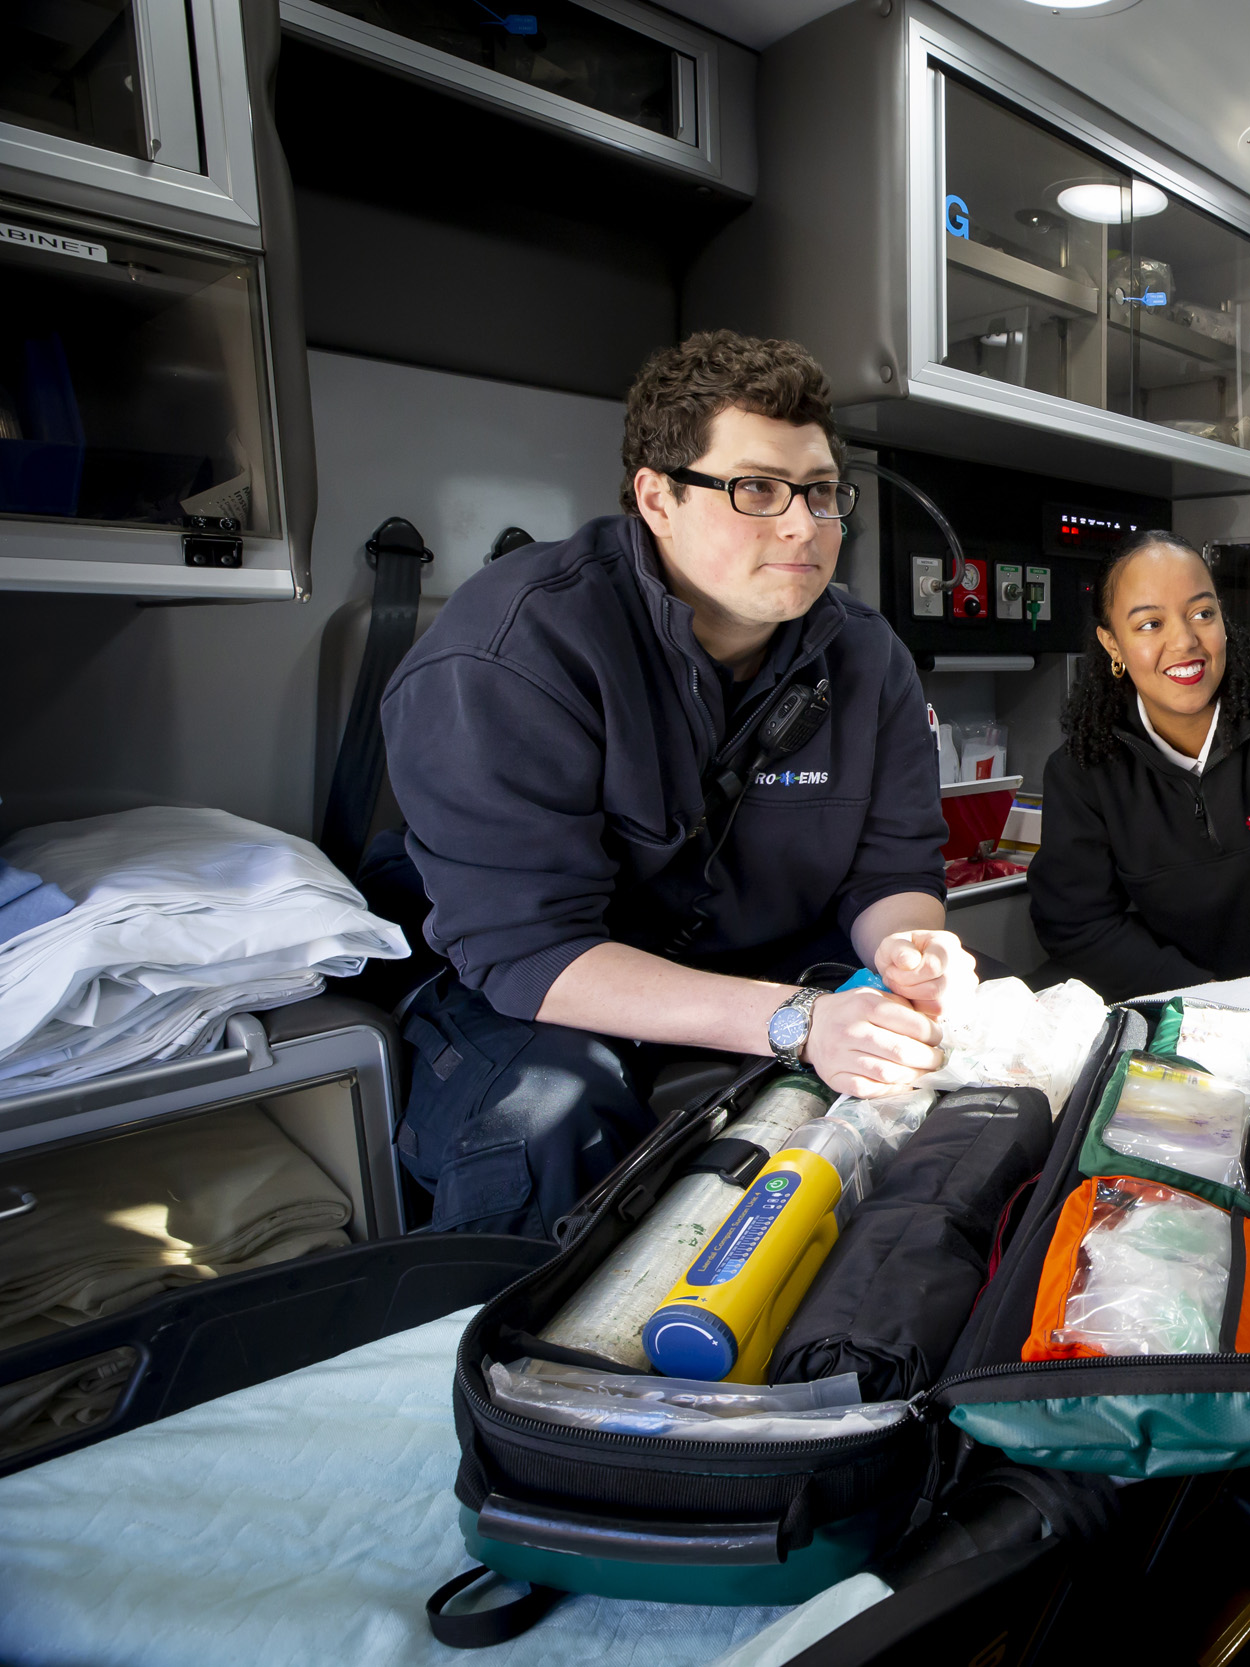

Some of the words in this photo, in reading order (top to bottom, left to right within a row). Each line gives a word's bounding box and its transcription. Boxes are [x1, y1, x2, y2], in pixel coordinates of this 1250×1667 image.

[946, 194, 969, 240] G
[0, 228, 99, 256] BINET
[799, 771, 829, 785] EMS
[713, 1227, 736, 1251] Compact
[731, 1207, 750, 1227] Suction
[745, 1196, 760, 1209] Unit
